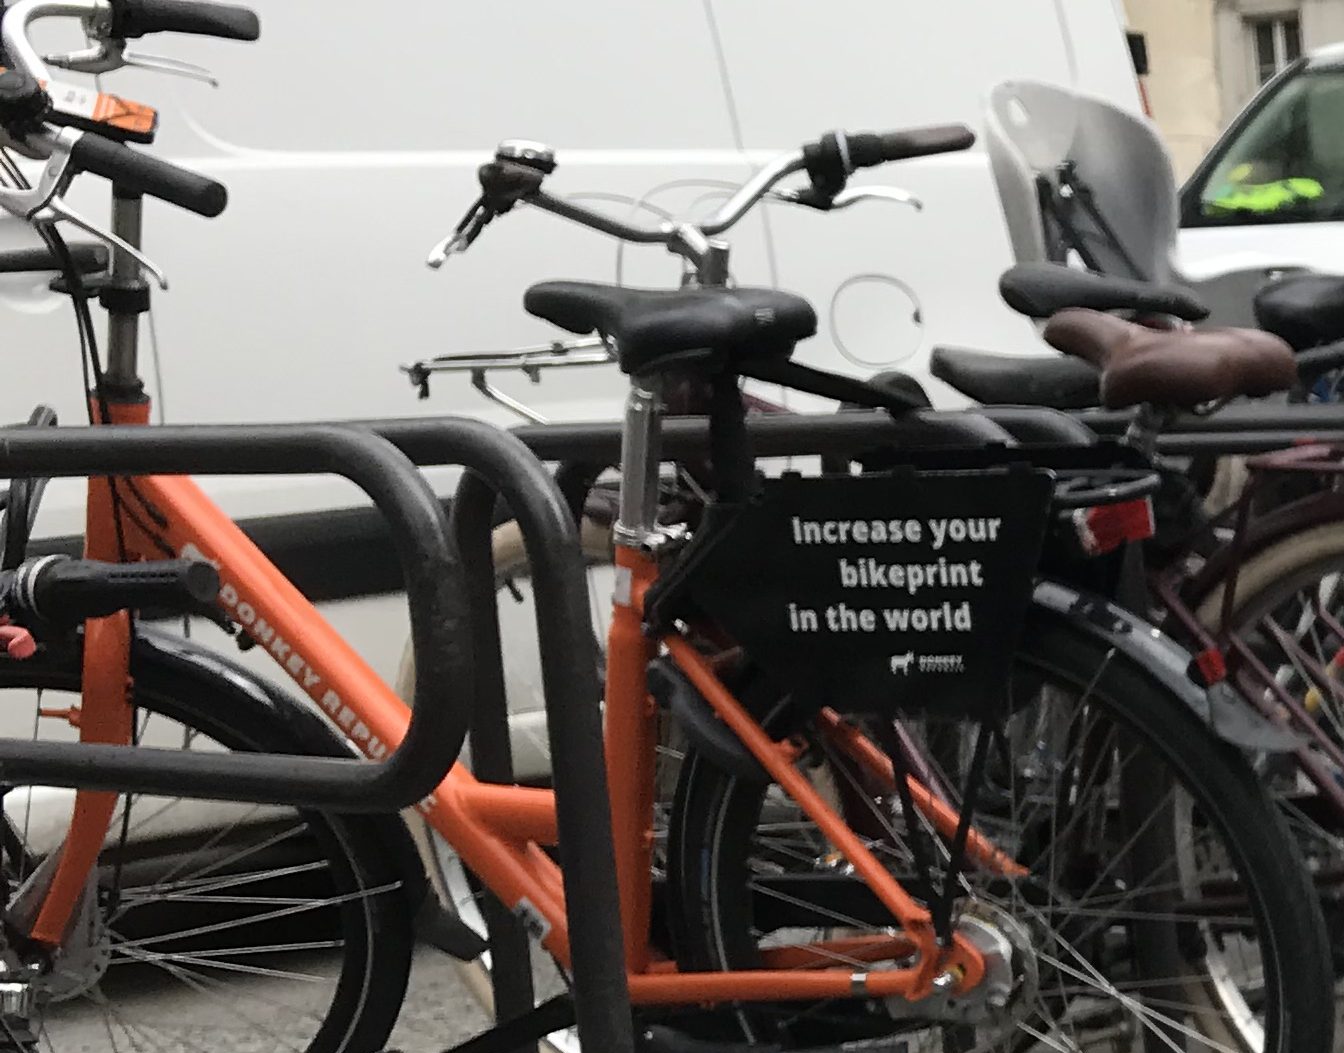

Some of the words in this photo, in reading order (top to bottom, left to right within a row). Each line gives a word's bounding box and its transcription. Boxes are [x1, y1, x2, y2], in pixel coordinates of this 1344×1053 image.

[792, 516, 922, 545] Increase
[928, 517, 1002, 550] your
[839, 556, 984, 595] bikeprint
[788, 602, 819, 632] in
[825, 602, 876, 632] the
[883, 601, 972, 632] world
[219, 584, 321, 688] DONKEY
